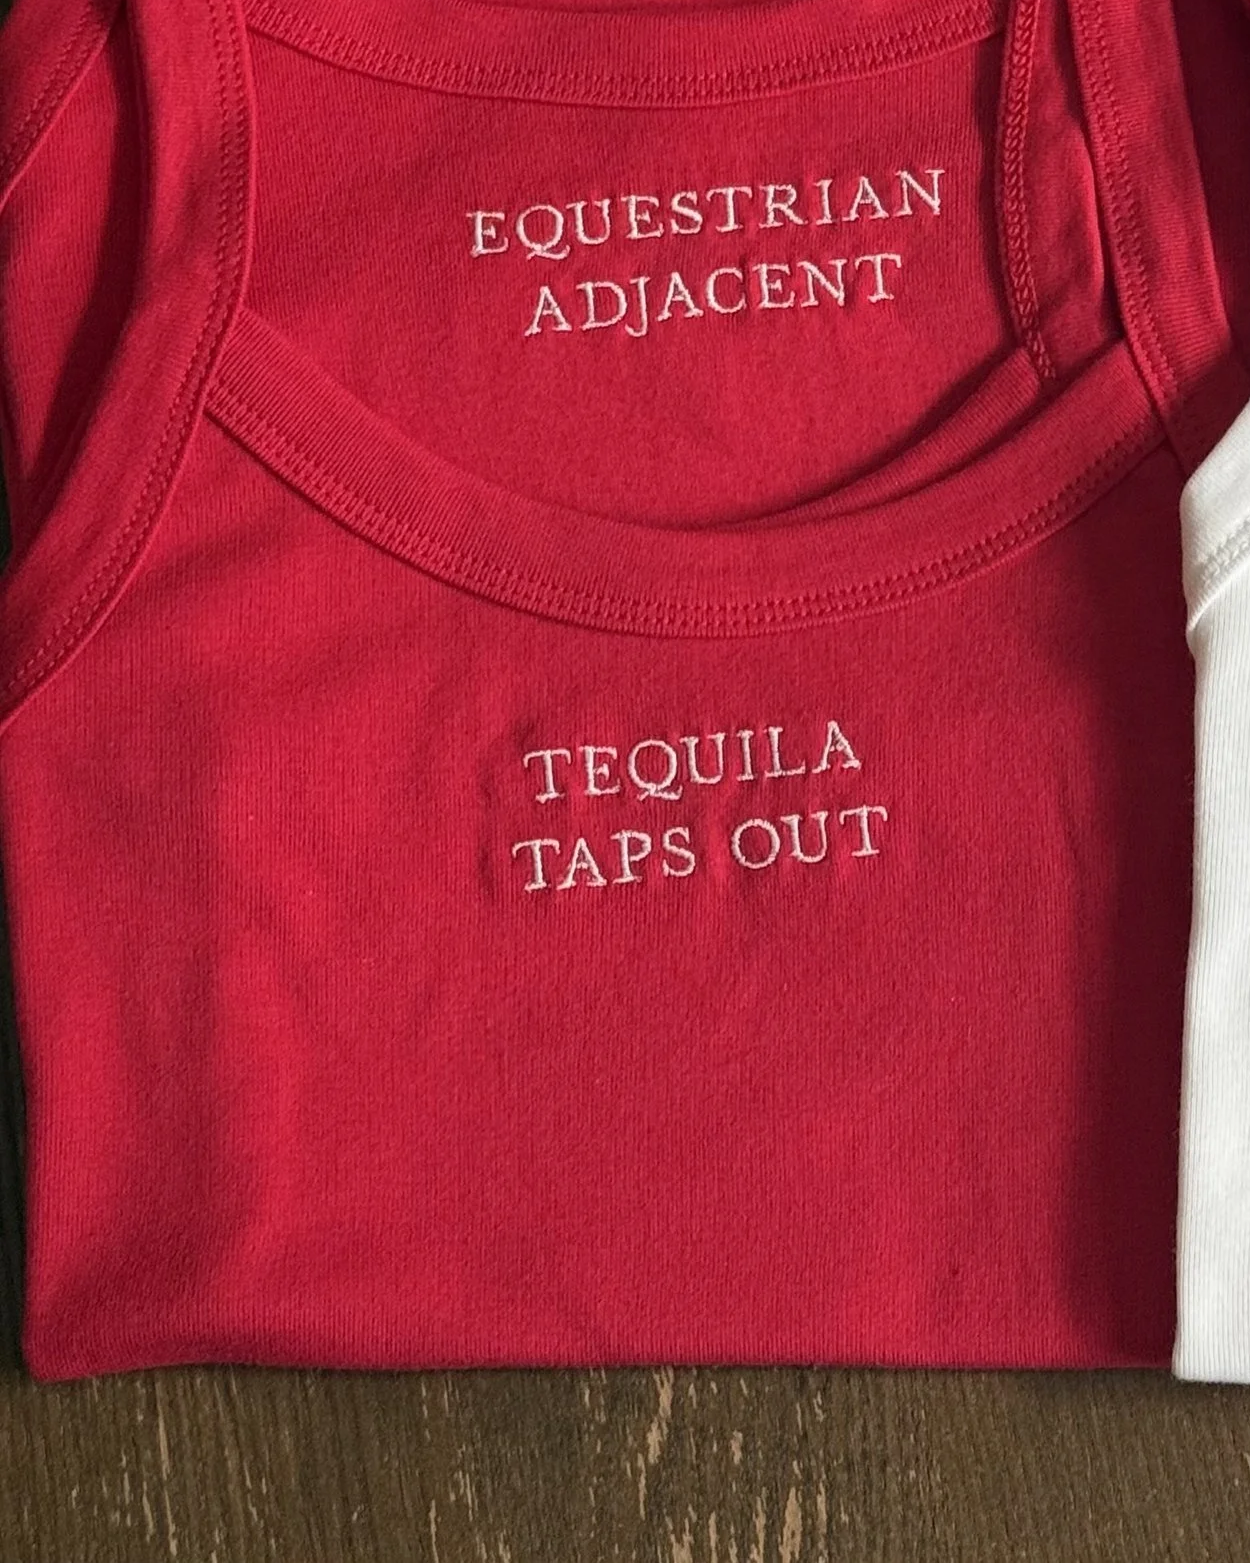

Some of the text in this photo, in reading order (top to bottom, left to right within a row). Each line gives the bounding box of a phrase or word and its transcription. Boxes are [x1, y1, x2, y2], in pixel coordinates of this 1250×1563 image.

[470, 169, 946, 261] EQUESTRIAN
[524, 252, 903, 338] ADJACENT
[522, 720, 863, 805] TEQUILA
[511, 804, 889, 892] TAPS OUT
